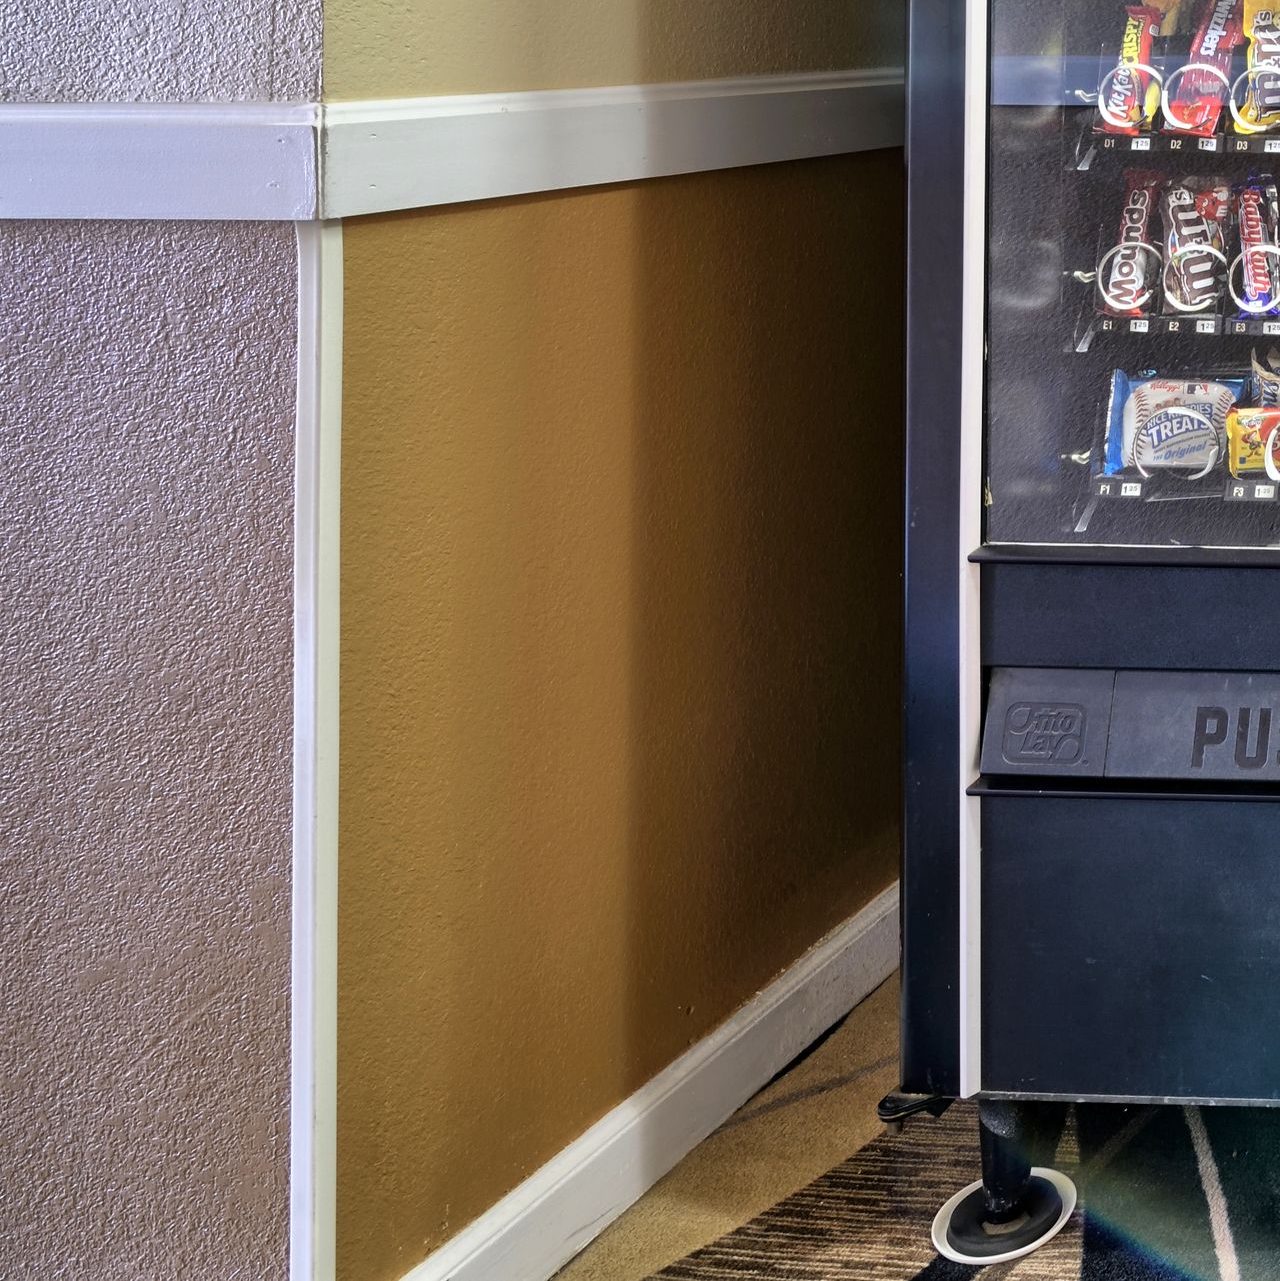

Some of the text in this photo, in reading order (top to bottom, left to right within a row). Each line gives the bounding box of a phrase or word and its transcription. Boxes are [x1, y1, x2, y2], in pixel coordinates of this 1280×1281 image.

[1122, 17, 1141, 65] CRISPY
[1104, 139, 1115, 147] D1
[1171, 140, 1181, 149] D2
[1237, 140, 1248, 150] D3
[1107, 190, 1149, 305] Mounds
[1240, 190, 1272, 299] Baby Ruth
[1103, 320, 1112, 330] E1
[1169, 322, 1179, 331] E2
[1236, 323, 1246, 332] E3
[1150, 381, 1182, 392] Kellogg's
[1147, 410, 1168, 429] RICE
[1147, 415, 1211, 448] TREATS
[1164, 441, 1207, 461] Original
[1100, 485, 1110, 494] F1
[1233, 487, 1244, 496] F3
[1010, 704, 1074, 733] Frito
[1019, 728, 1076, 763] Lay
